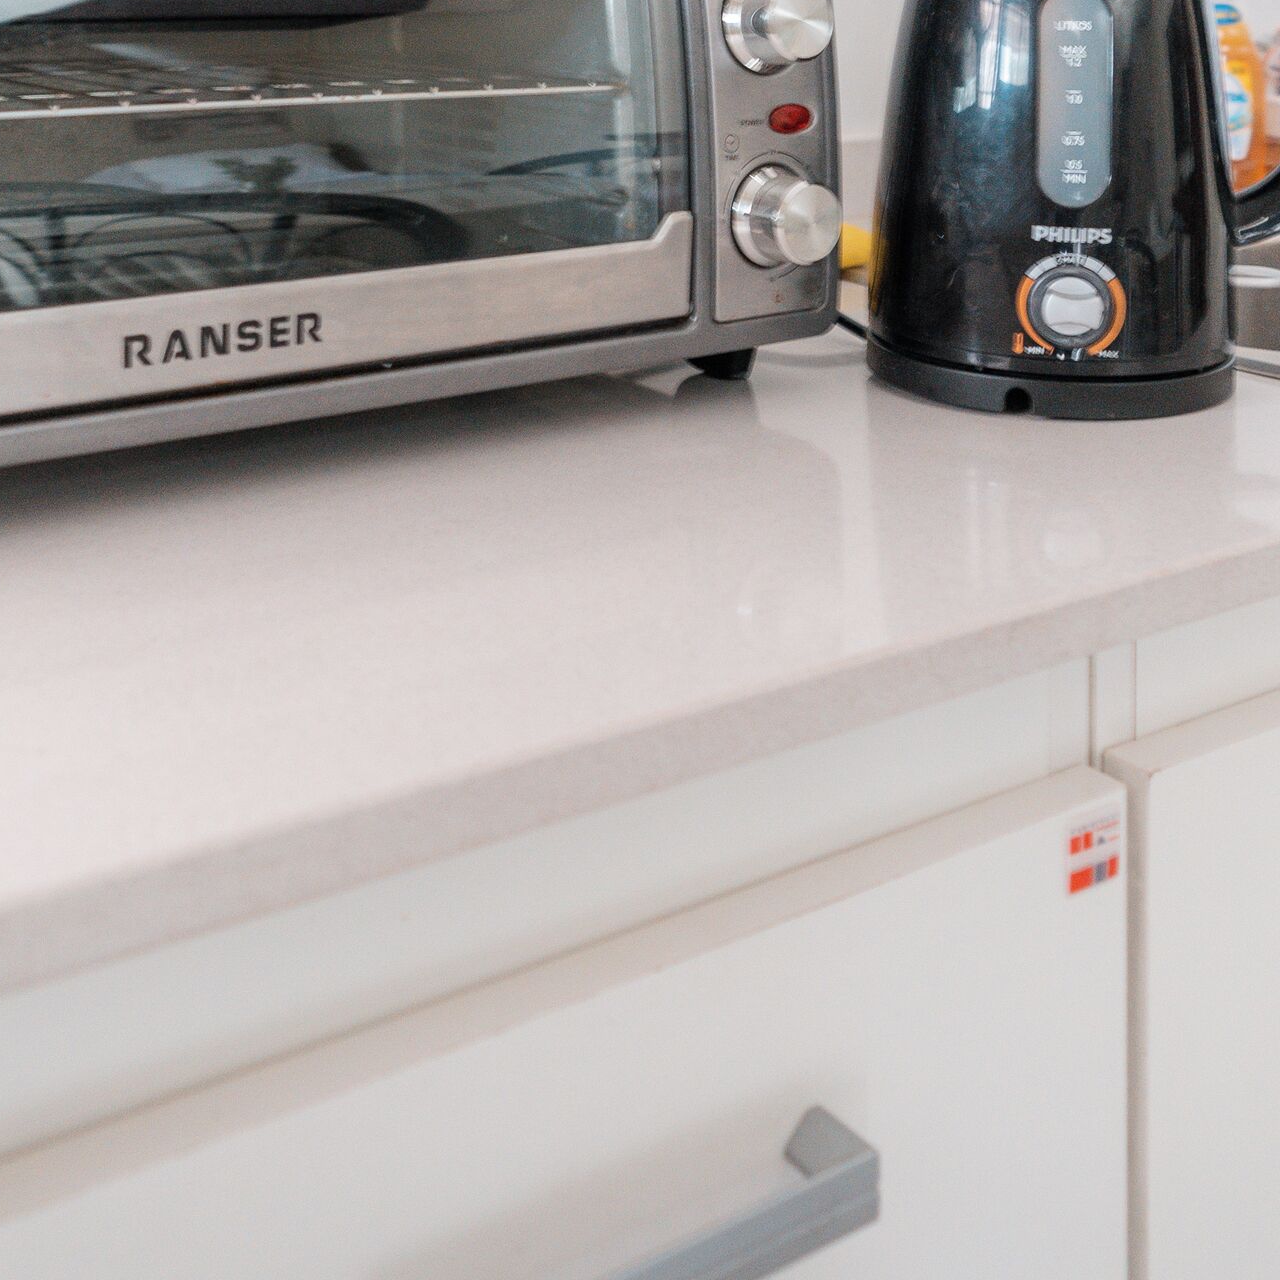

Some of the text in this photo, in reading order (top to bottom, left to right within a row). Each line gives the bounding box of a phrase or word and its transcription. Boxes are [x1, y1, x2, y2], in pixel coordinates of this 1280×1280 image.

[1059, 45, 1087, 55] MAX
[1062, 135, 1086, 146] 0.75
[1062, 173, 1087, 184] MIN
[1031, 225, 1113, 245] PHILIPS
[122, 312, 323, 369] RANSER
